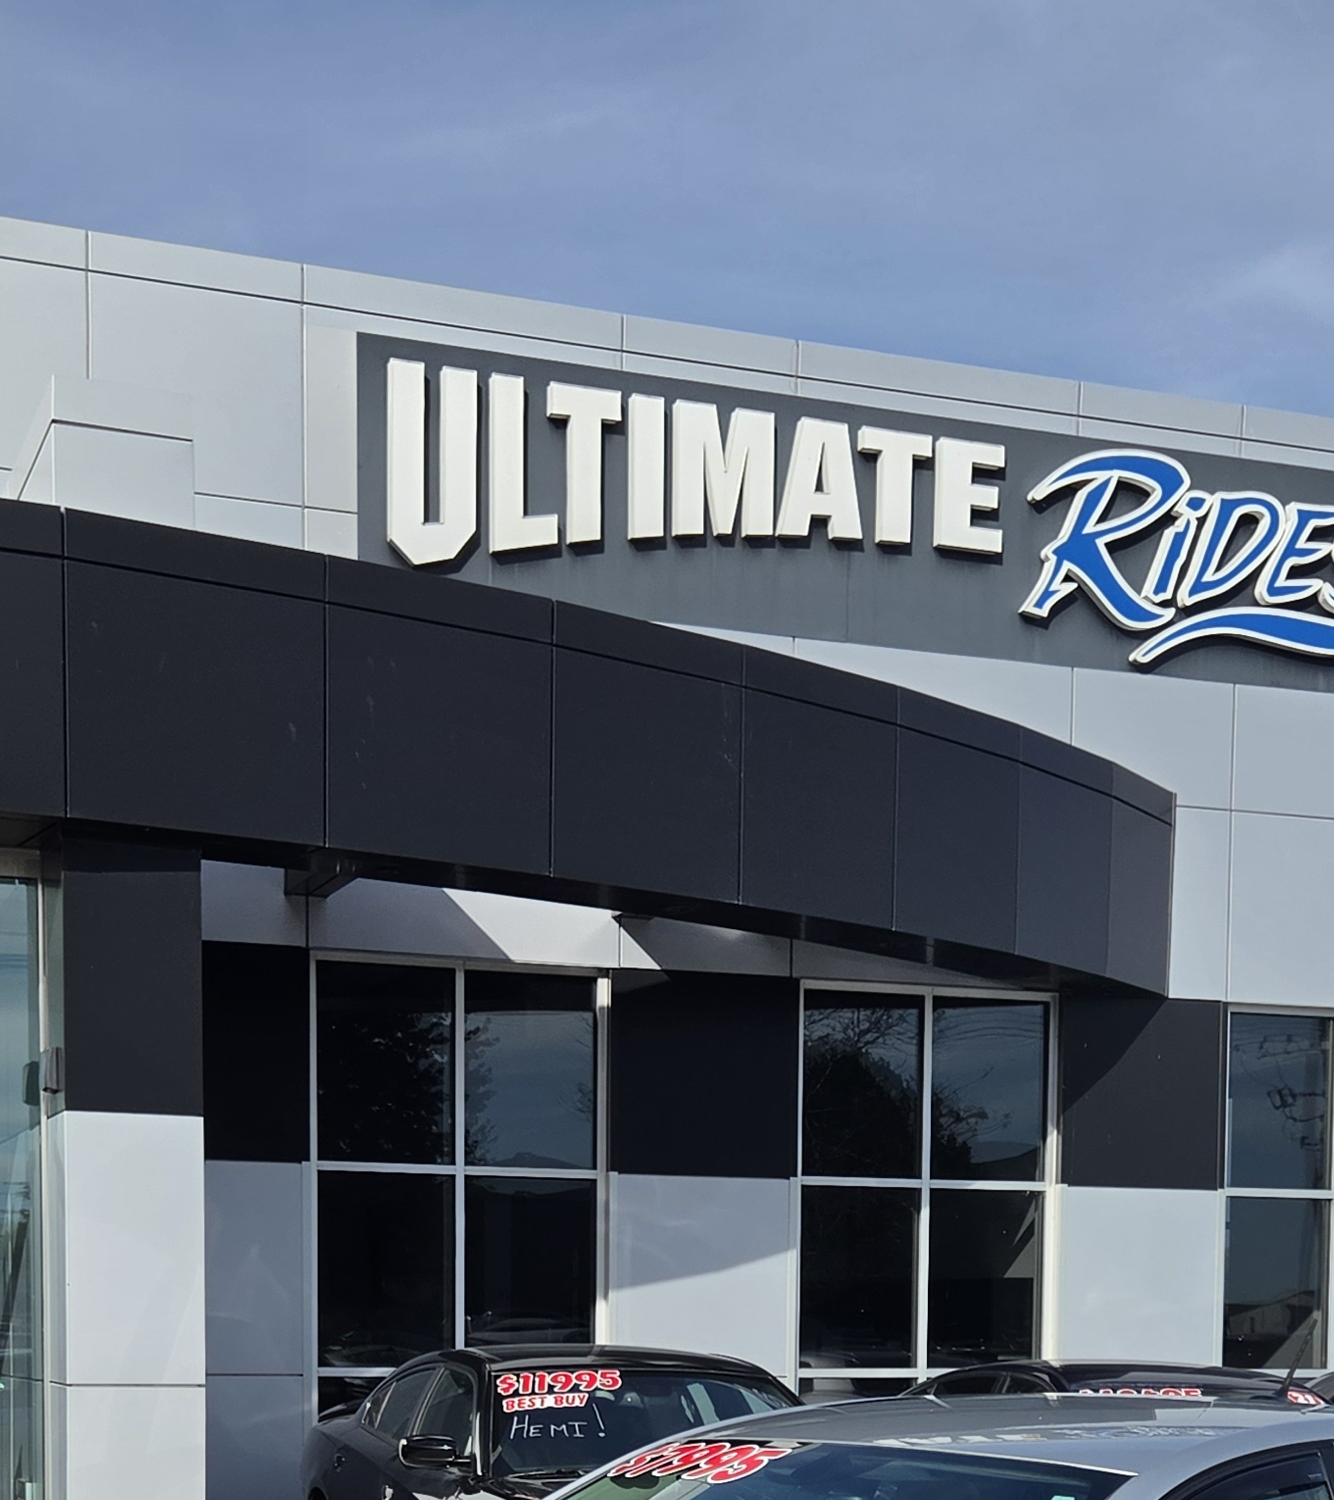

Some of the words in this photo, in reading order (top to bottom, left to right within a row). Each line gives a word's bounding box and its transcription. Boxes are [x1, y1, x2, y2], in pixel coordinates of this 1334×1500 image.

[387, 358, 1006, 567] ULTIMATE
[496, 1369, 622, 1396] $11995
[503, 1395, 548, 1412] BEST
[553, 1393, 588, 1408] BUY
